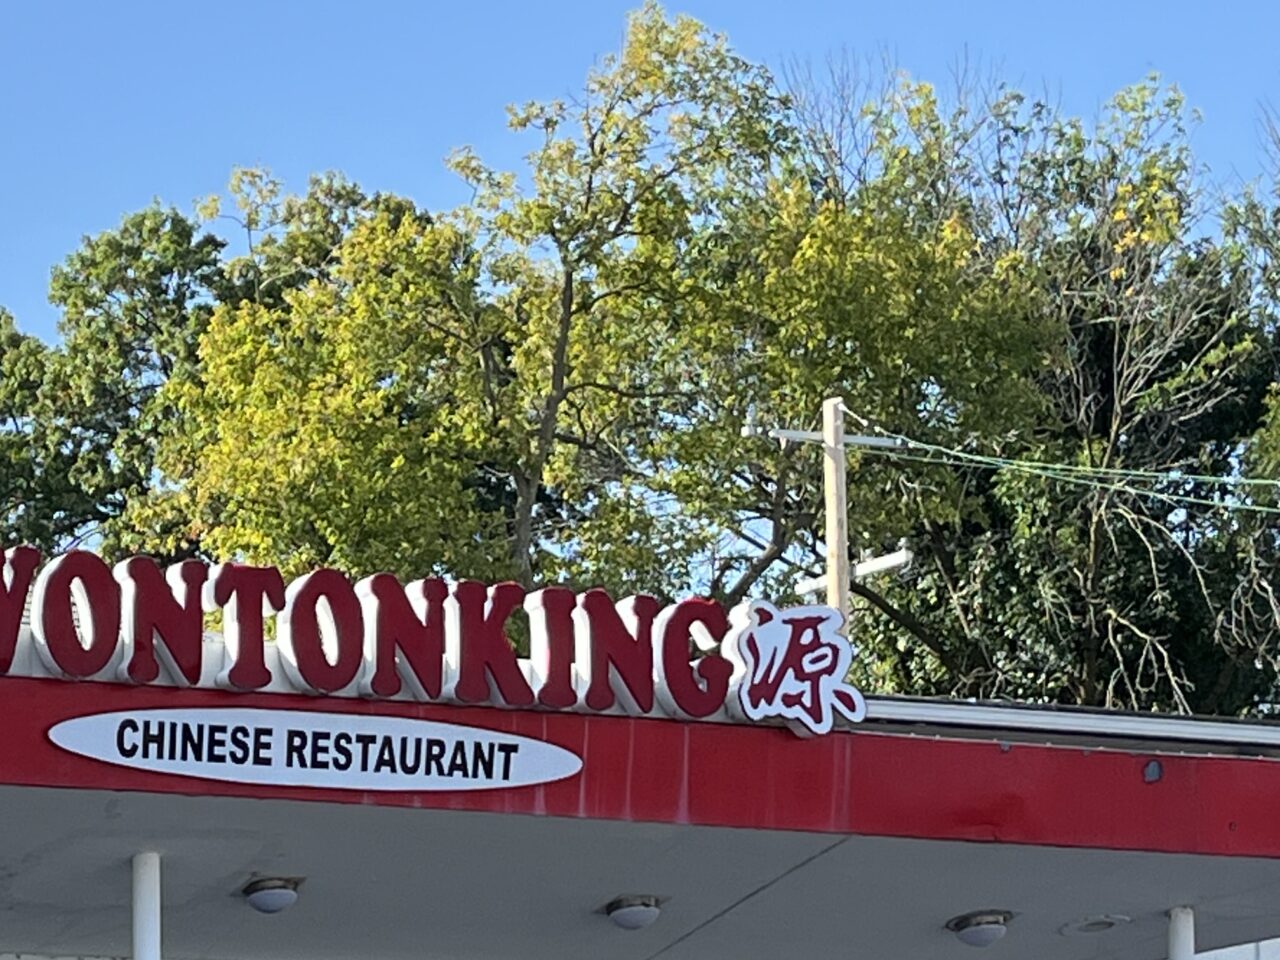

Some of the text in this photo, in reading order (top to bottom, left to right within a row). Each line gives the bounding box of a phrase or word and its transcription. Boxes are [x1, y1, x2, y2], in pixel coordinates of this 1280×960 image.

[742, 603, 864, 730] 源
[116, 718, 519, 781] CHINESE RESTAURANT
